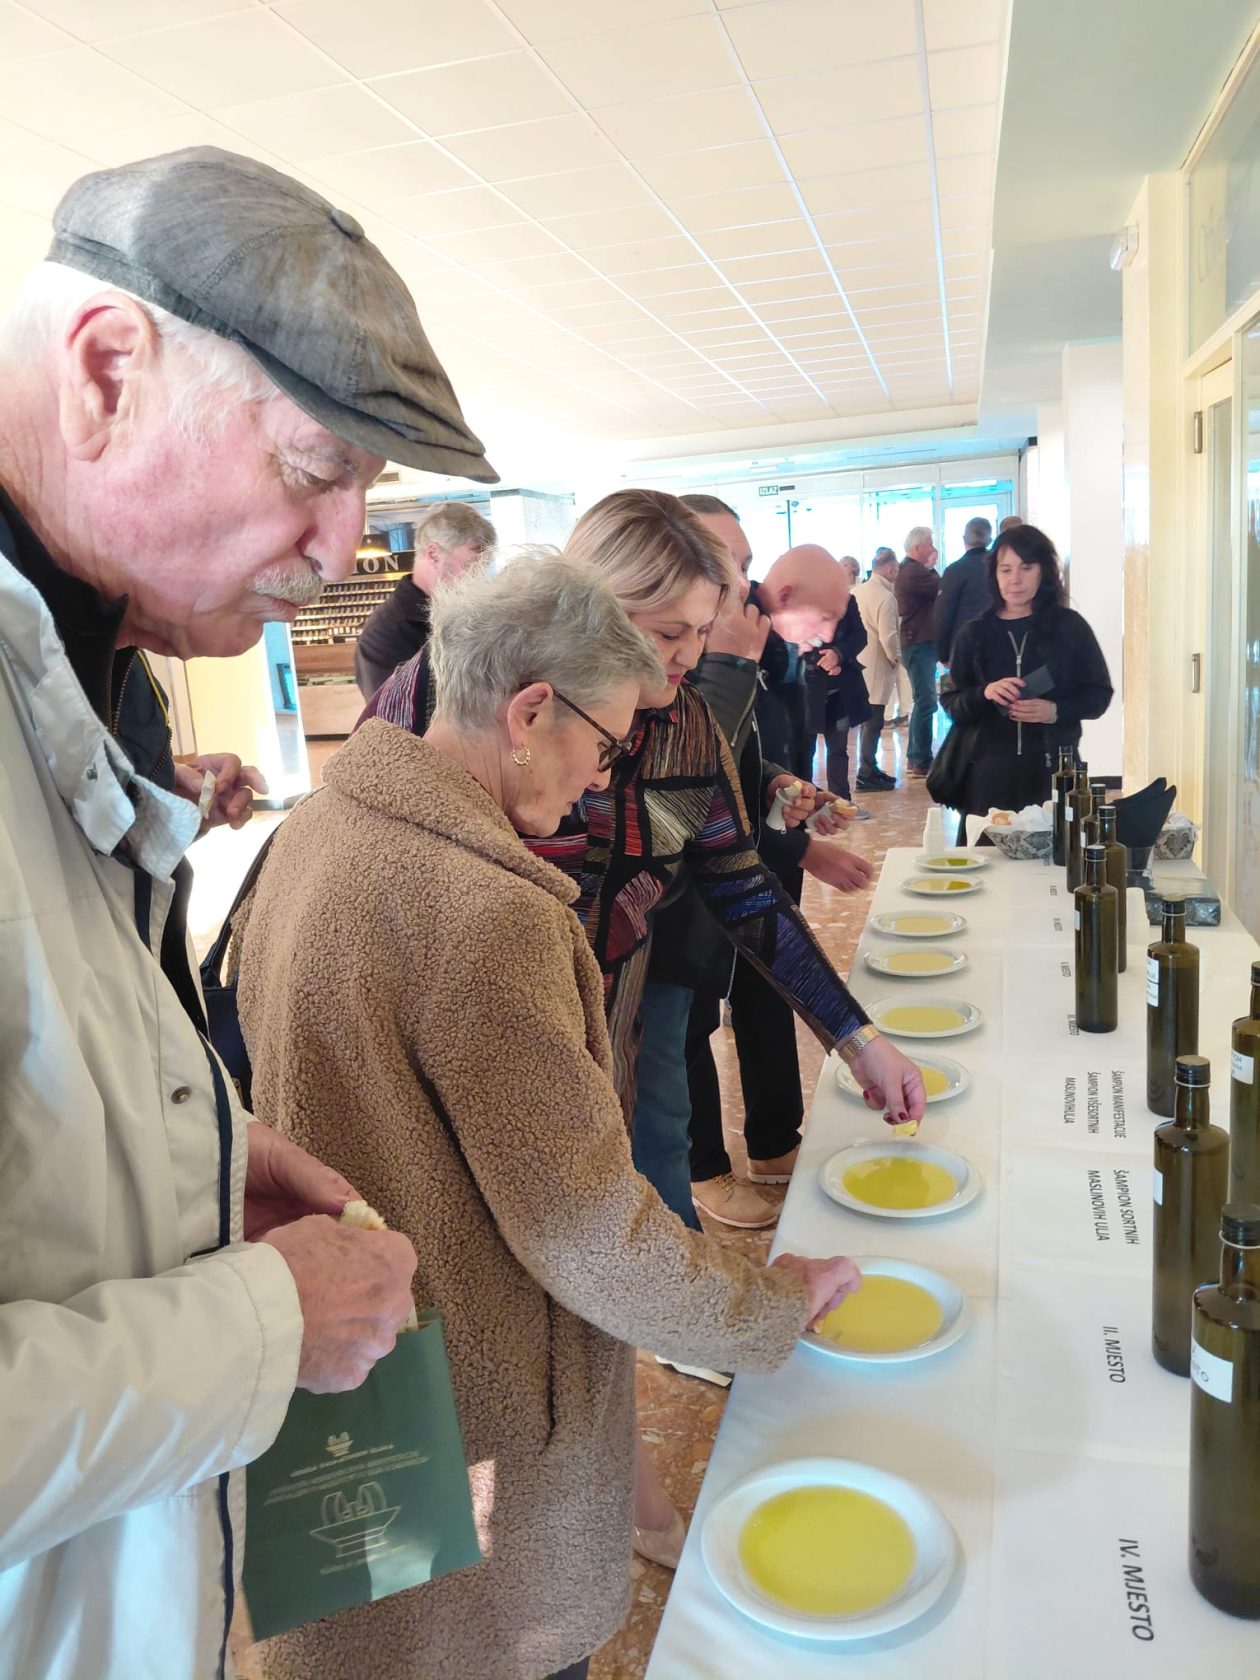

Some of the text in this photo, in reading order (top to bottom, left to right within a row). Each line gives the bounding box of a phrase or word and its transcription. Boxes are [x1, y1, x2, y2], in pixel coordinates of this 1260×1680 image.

[1087, 1071, 1102, 1096] ŠAMPION
[1111, 1070, 1126, 1094] ŠAMPION
[1087, 1170, 1111, 1242] MASLINOVIH ULJA
[1113, 1169, 1140, 1245] ŠAMPION SORTNIH
[1103, 1326, 1126, 1384] II. MJESTO
[1118, 1538, 1155, 1641] IV. MJESTO
